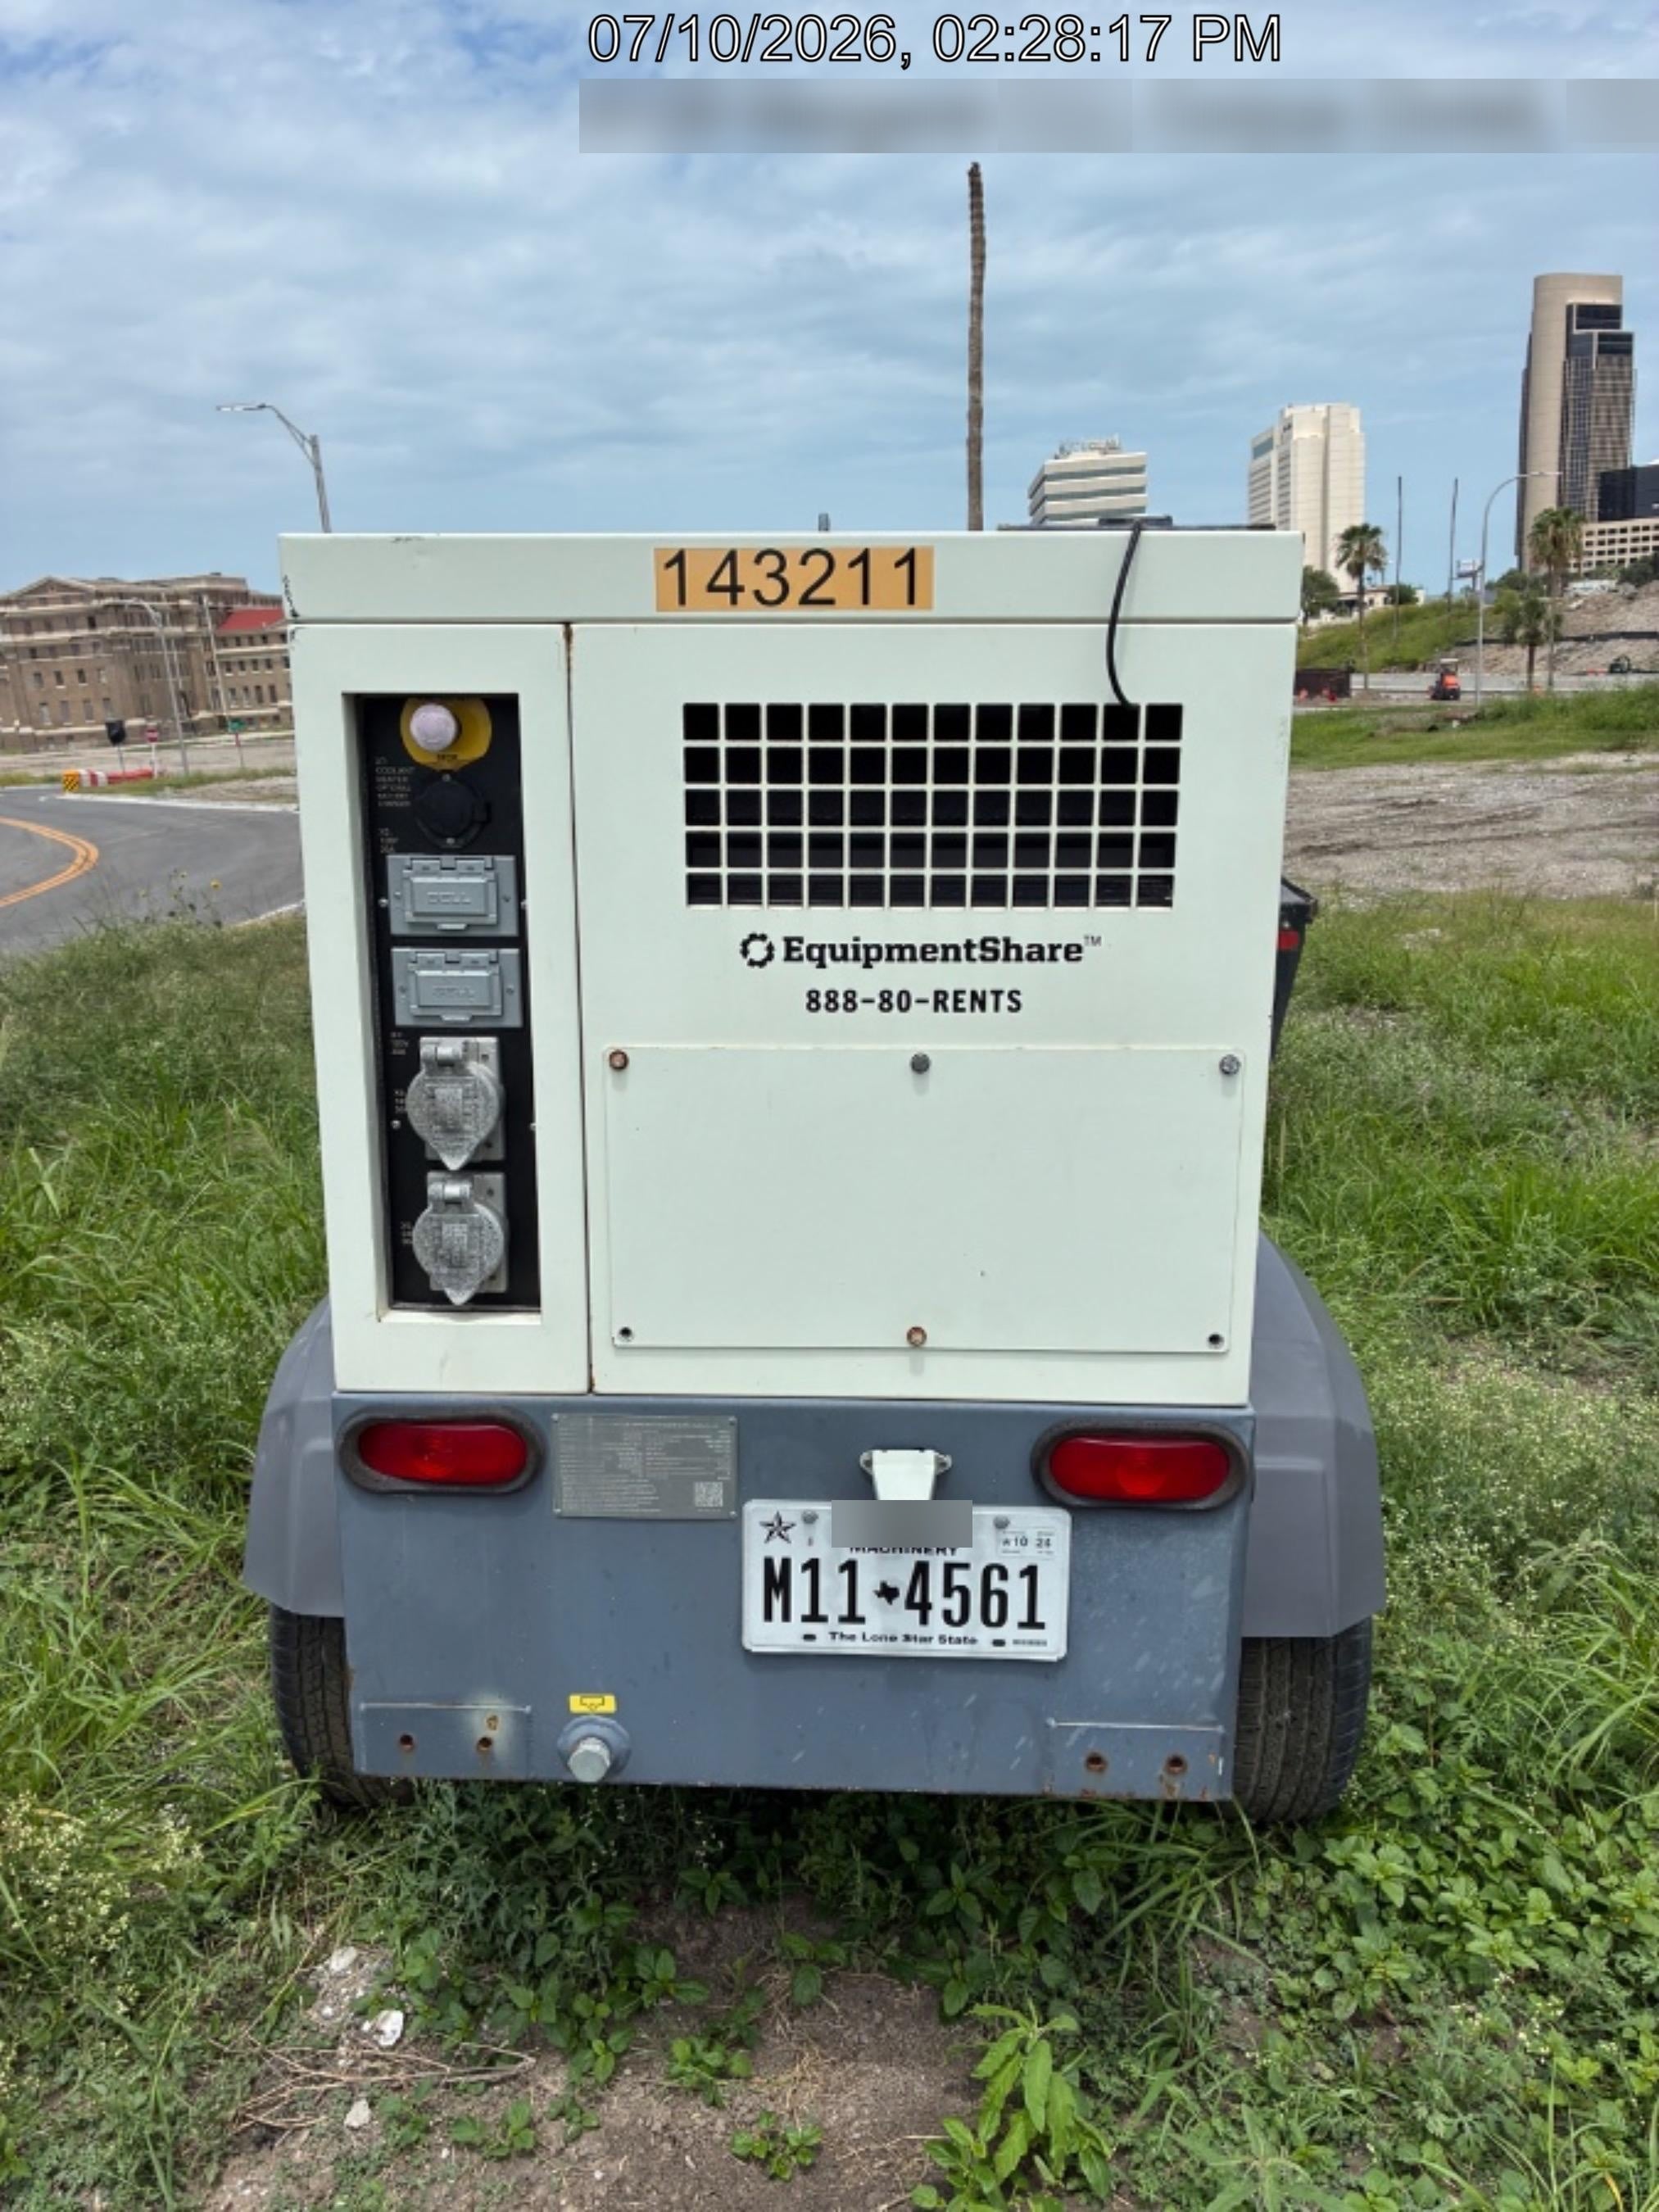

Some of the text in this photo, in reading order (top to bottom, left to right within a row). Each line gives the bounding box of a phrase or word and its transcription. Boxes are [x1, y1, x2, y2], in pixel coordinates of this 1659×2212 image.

[663, 547, 917, 606] 143211
[805, 989, 1022, 1013] 888-80-RENTS
[763, 1557, 1045, 1630] M11 4561
[828, 1631, 856, 1642] The
[862, 1632, 898, 1643] Lone
[938, 1634, 978, 1645] State
